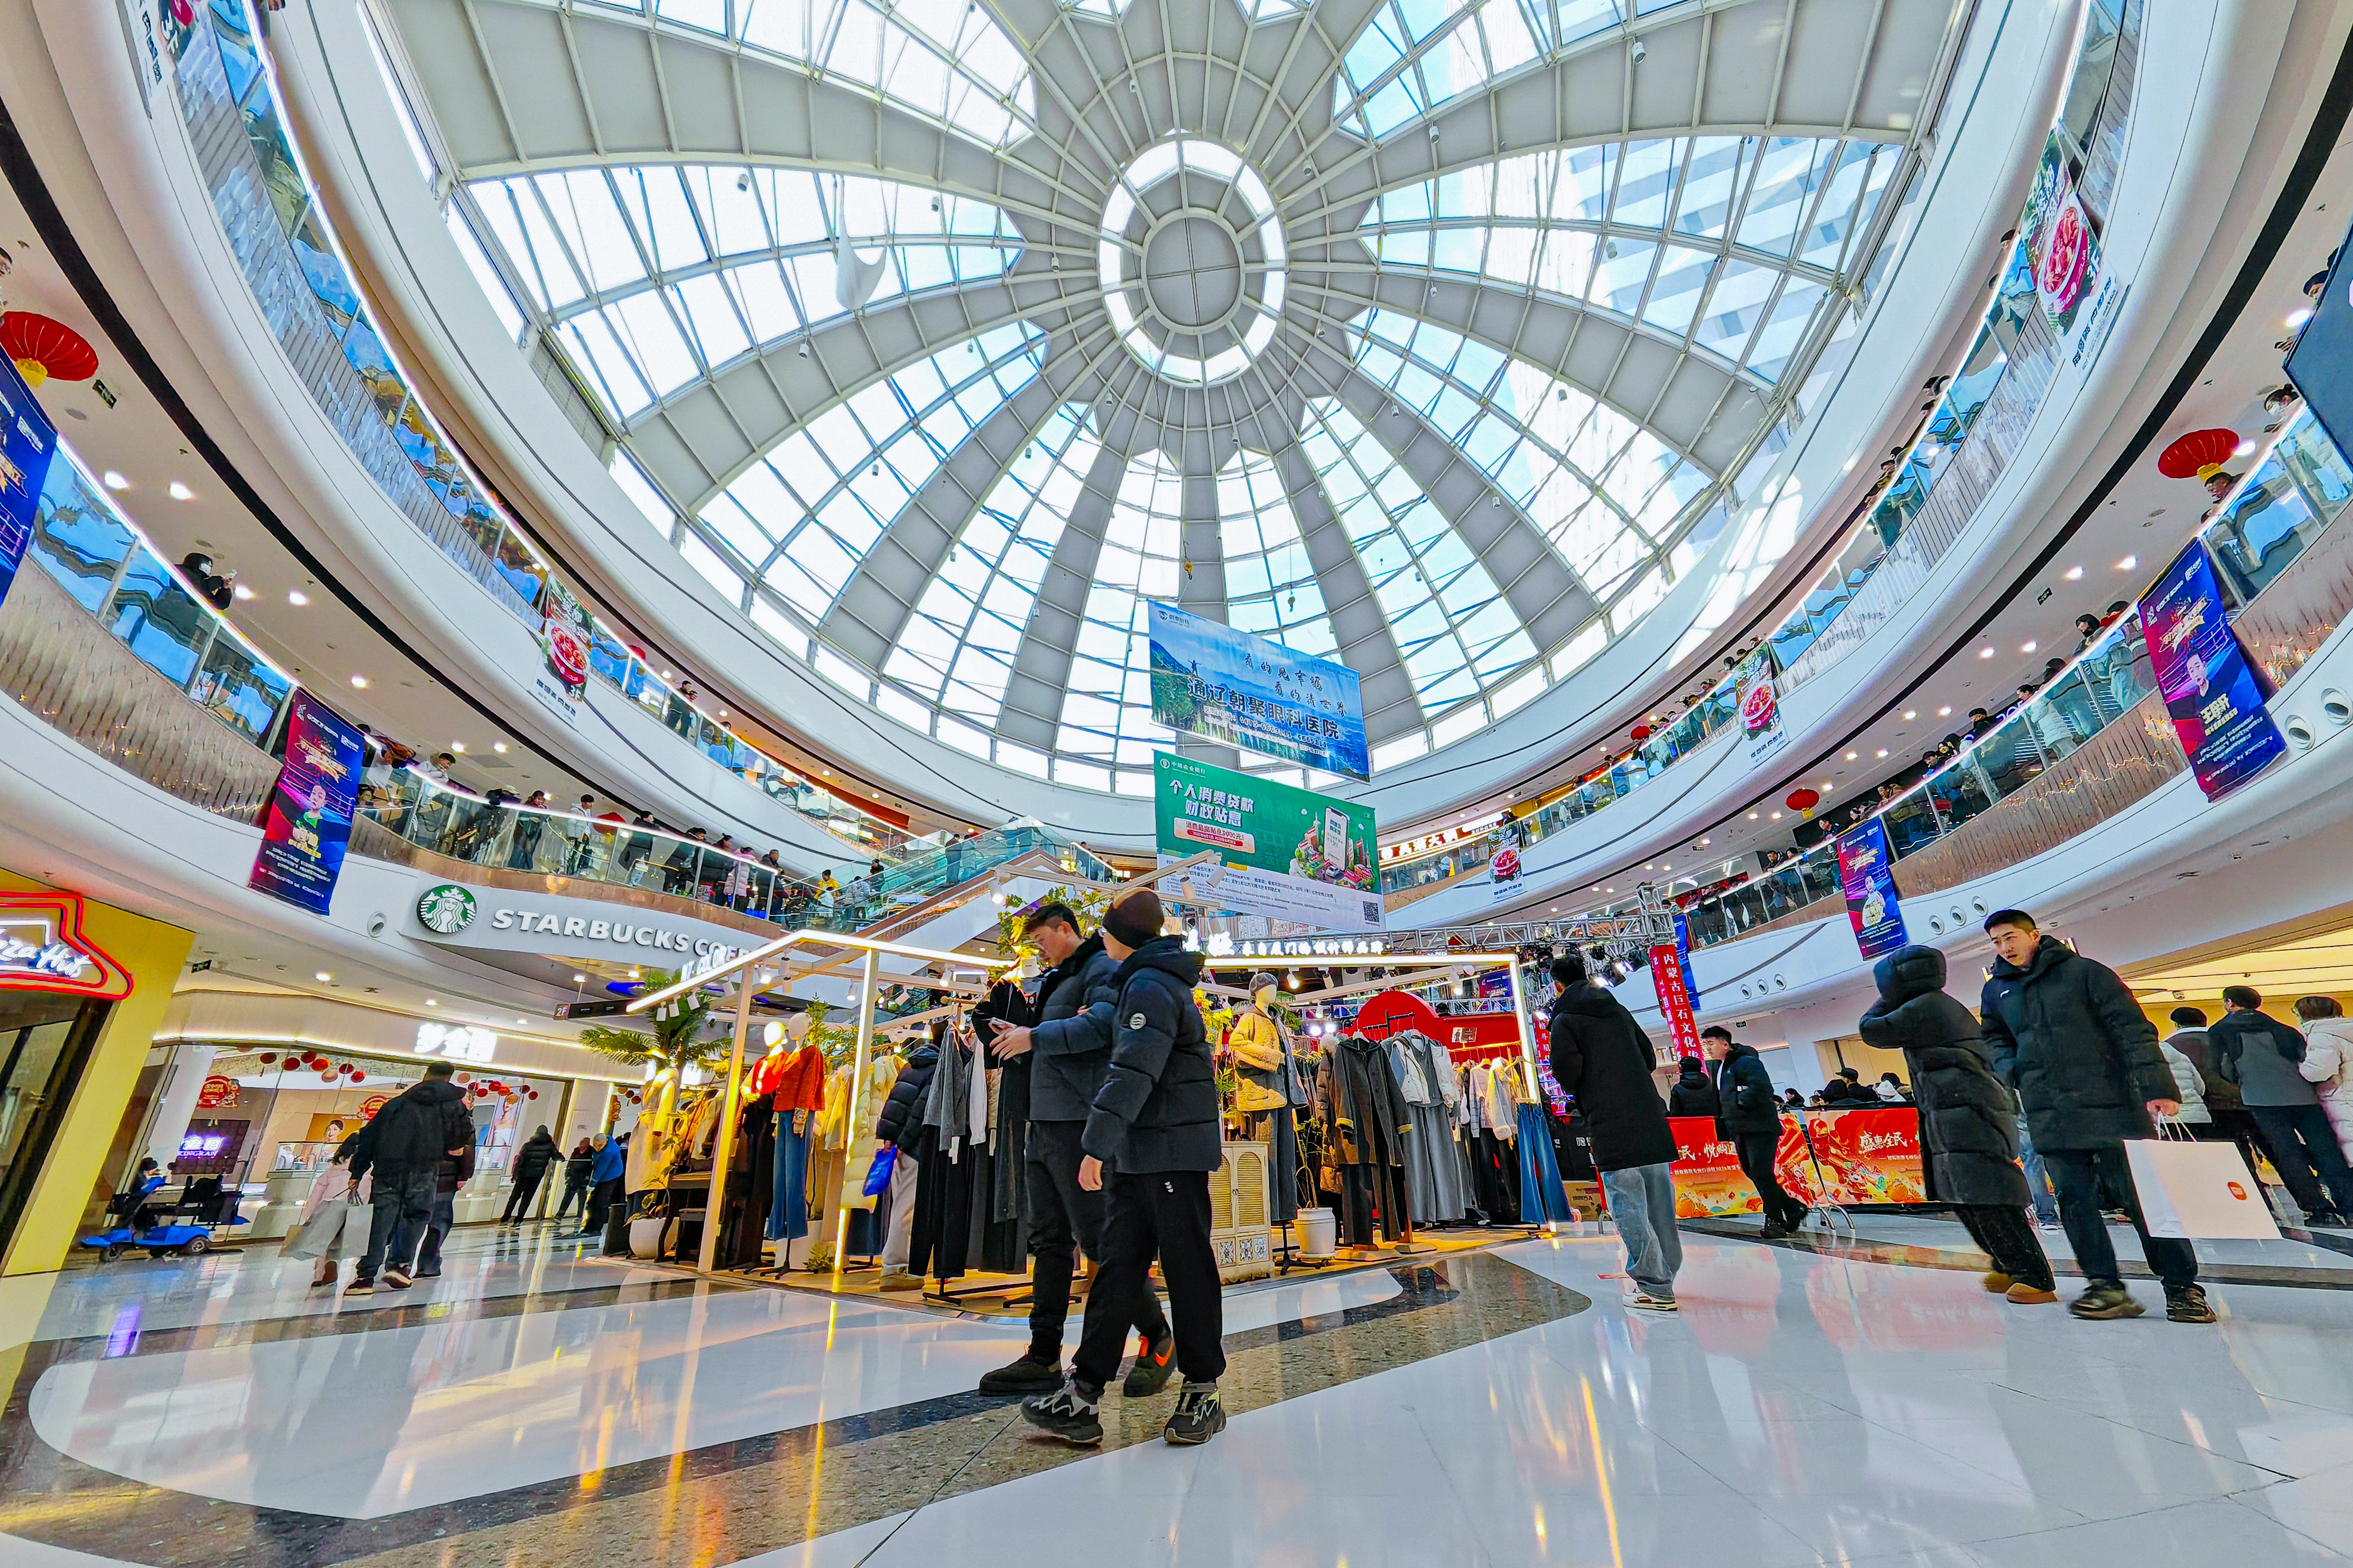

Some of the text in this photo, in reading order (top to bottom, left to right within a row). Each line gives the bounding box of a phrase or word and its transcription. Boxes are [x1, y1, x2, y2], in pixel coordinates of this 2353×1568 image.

[2087, 249, 2101, 286] 3F
[569, 685, 582, 701] 3F
[1275, 681, 1347, 717] 看的清世界
[1187, 677, 1340, 740] 通辽朝聚眼科医院
[1769, 716, 1780, 729] 3F
[1170, 779, 1255, 814] 个人消费贷款
[1185, 798, 1242, 828] 财政贴息
[1513, 871, 1521, 880] 3F
[491, 909, 689, 952] STARBUCKS
[36, 944, 93, 978] Hut
[556, 1007, 568, 1016] 2F
[180, 1134, 224, 1150] 金园
[1858, 1130, 1920, 1154] 盛惠全民·
